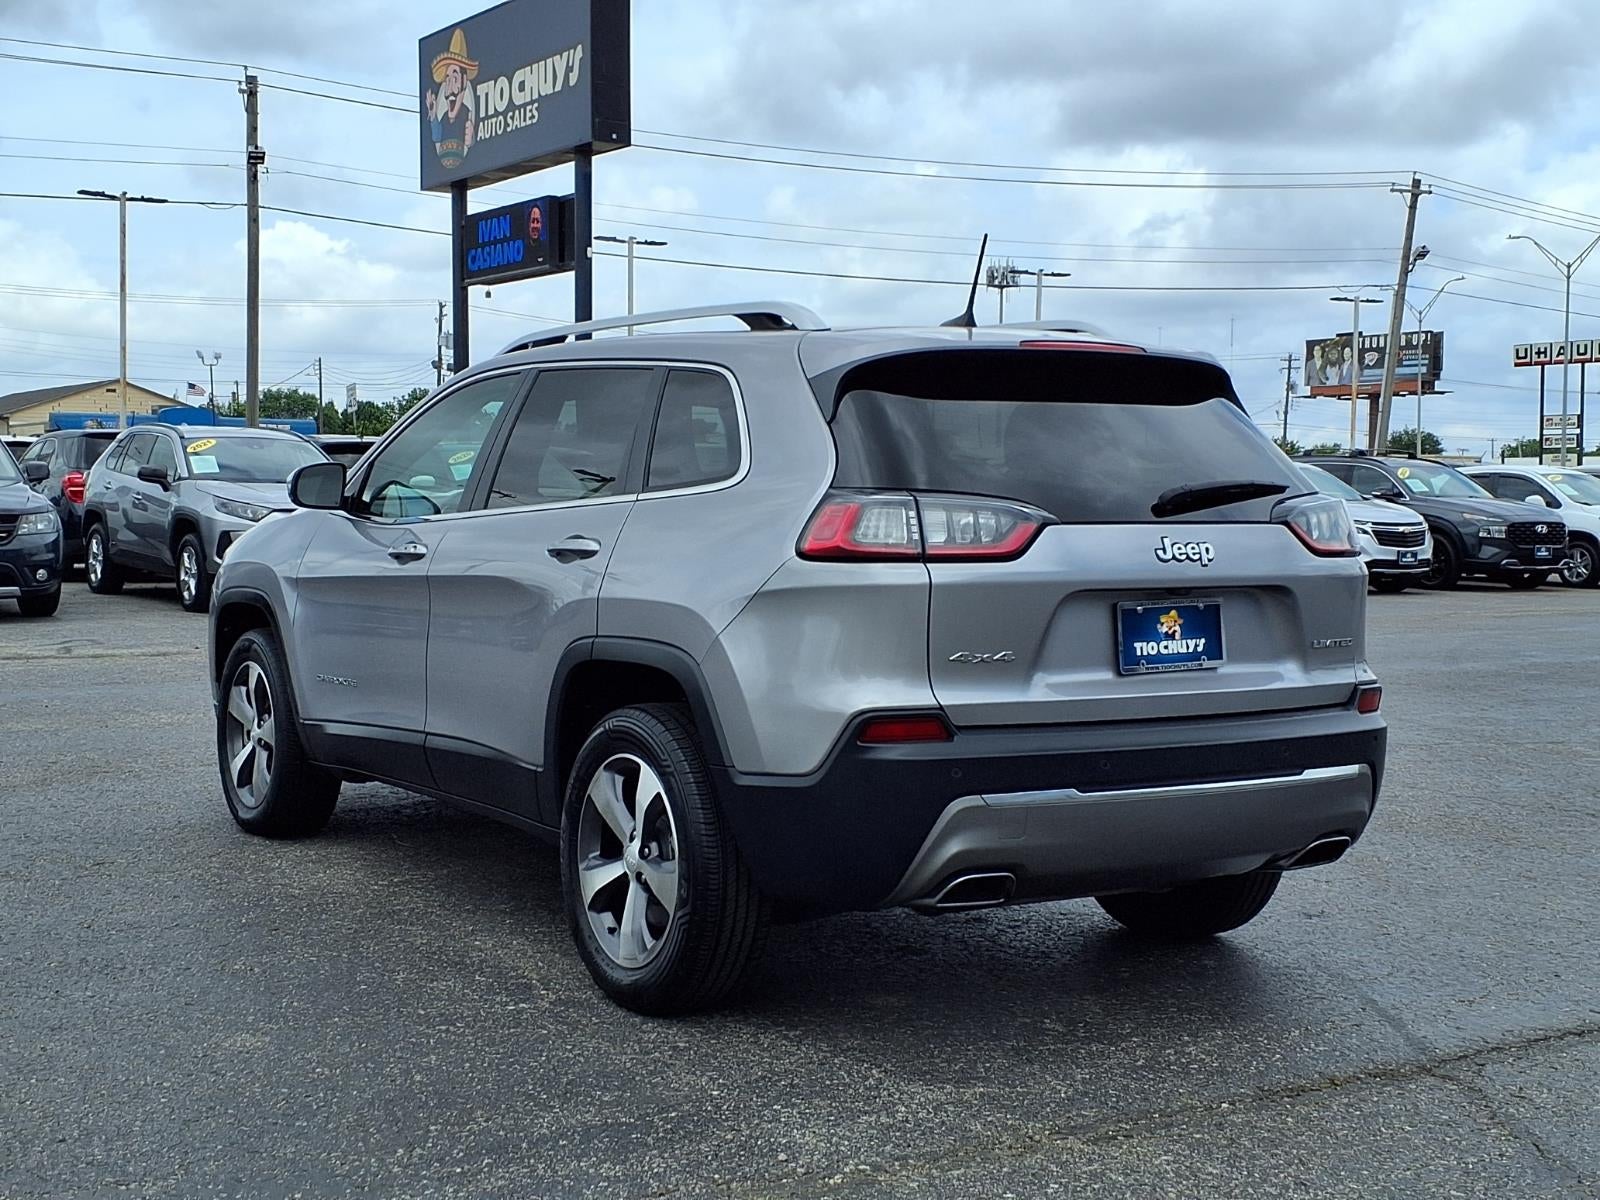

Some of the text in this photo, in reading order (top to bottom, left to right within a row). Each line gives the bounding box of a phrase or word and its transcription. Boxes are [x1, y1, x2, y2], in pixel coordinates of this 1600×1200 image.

[477, 44, 583, 118] TIO CHUY'S
[477, 103, 539, 141] AUTO SALES
[478, 214, 511, 243] IVAN
[467, 240, 524, 272] CASIANO
[1359, 335, 1406, 348] THUNR
[1154, 536, 1215, 567] Jeep
[1134, 638, 1206, 656] TIO CHUY'S
